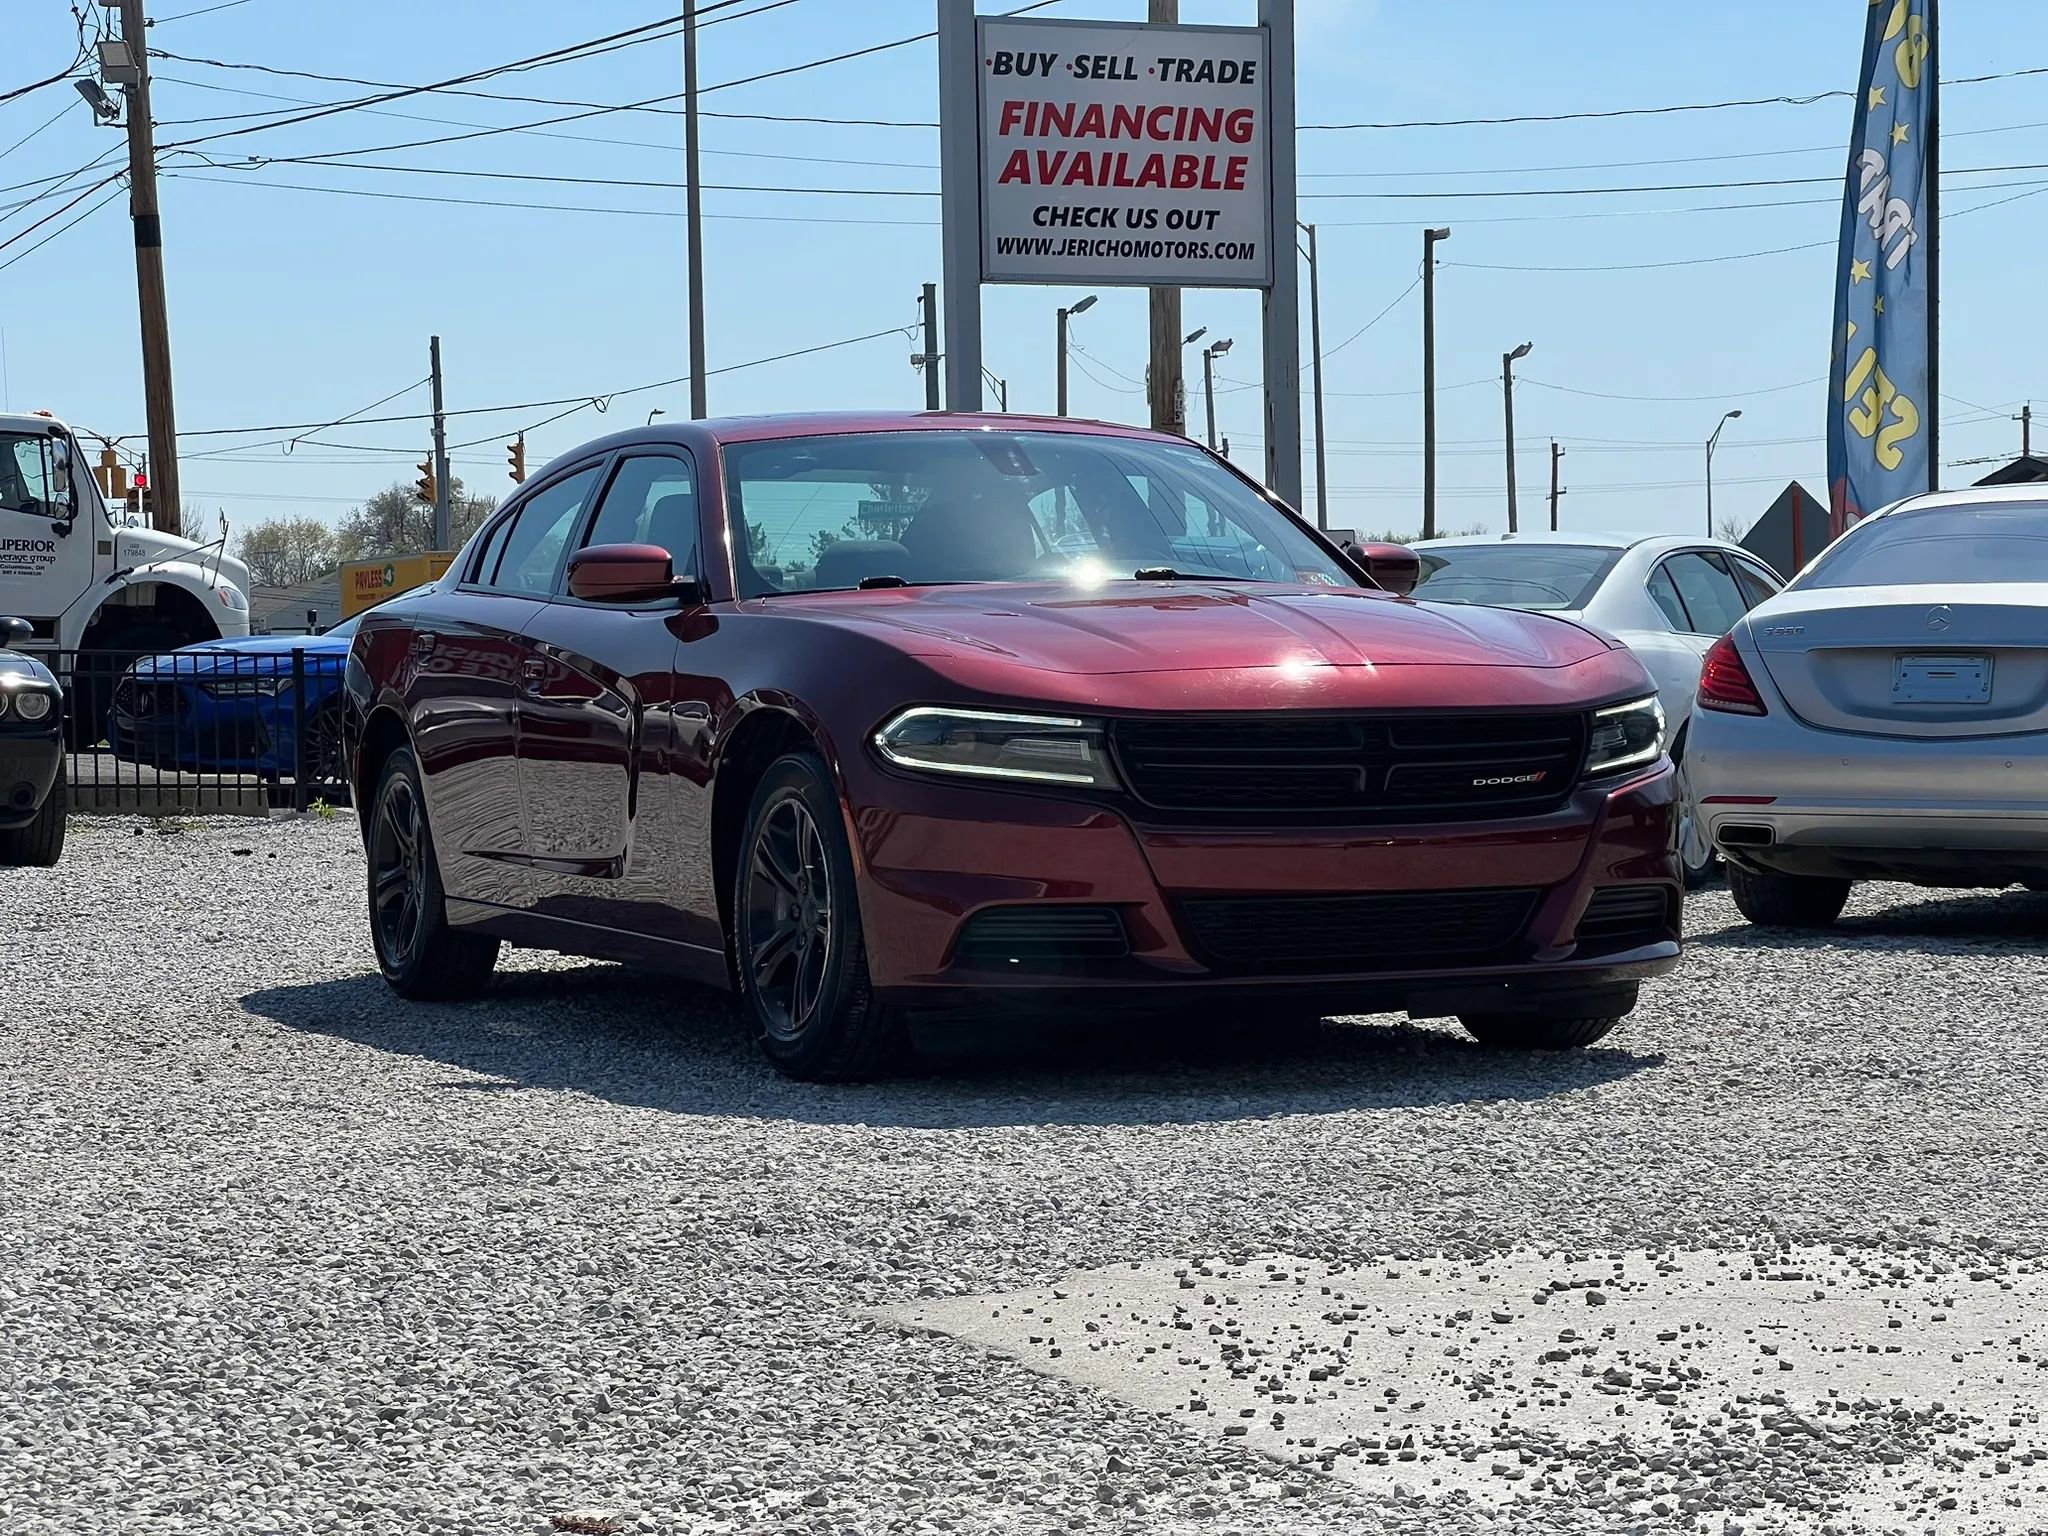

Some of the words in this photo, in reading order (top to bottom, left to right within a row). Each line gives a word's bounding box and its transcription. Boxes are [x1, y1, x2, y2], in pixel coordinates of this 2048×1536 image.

[992, 51, 1059, 78] BUY
[1072, 54, 1139, 81] SELL
[1156, 57, 1257, 85] TRADE
[998, 100, 1255, 144] FINANCING
[997, 149, 1249, 191] AVAILABLE
[1032, 205, 1120, 229] CHECK
[1125, 208, 1159, 229] US
[1165, 209, 1221, 231] OUT
[996, 237, 1255, 261] WWW.JERICHOMOTORS.COM
[30, 555, 56, 565] group
[355, 568, 383, 590] PAYLESS
[1472, 774, 1537, 786] DODGE
